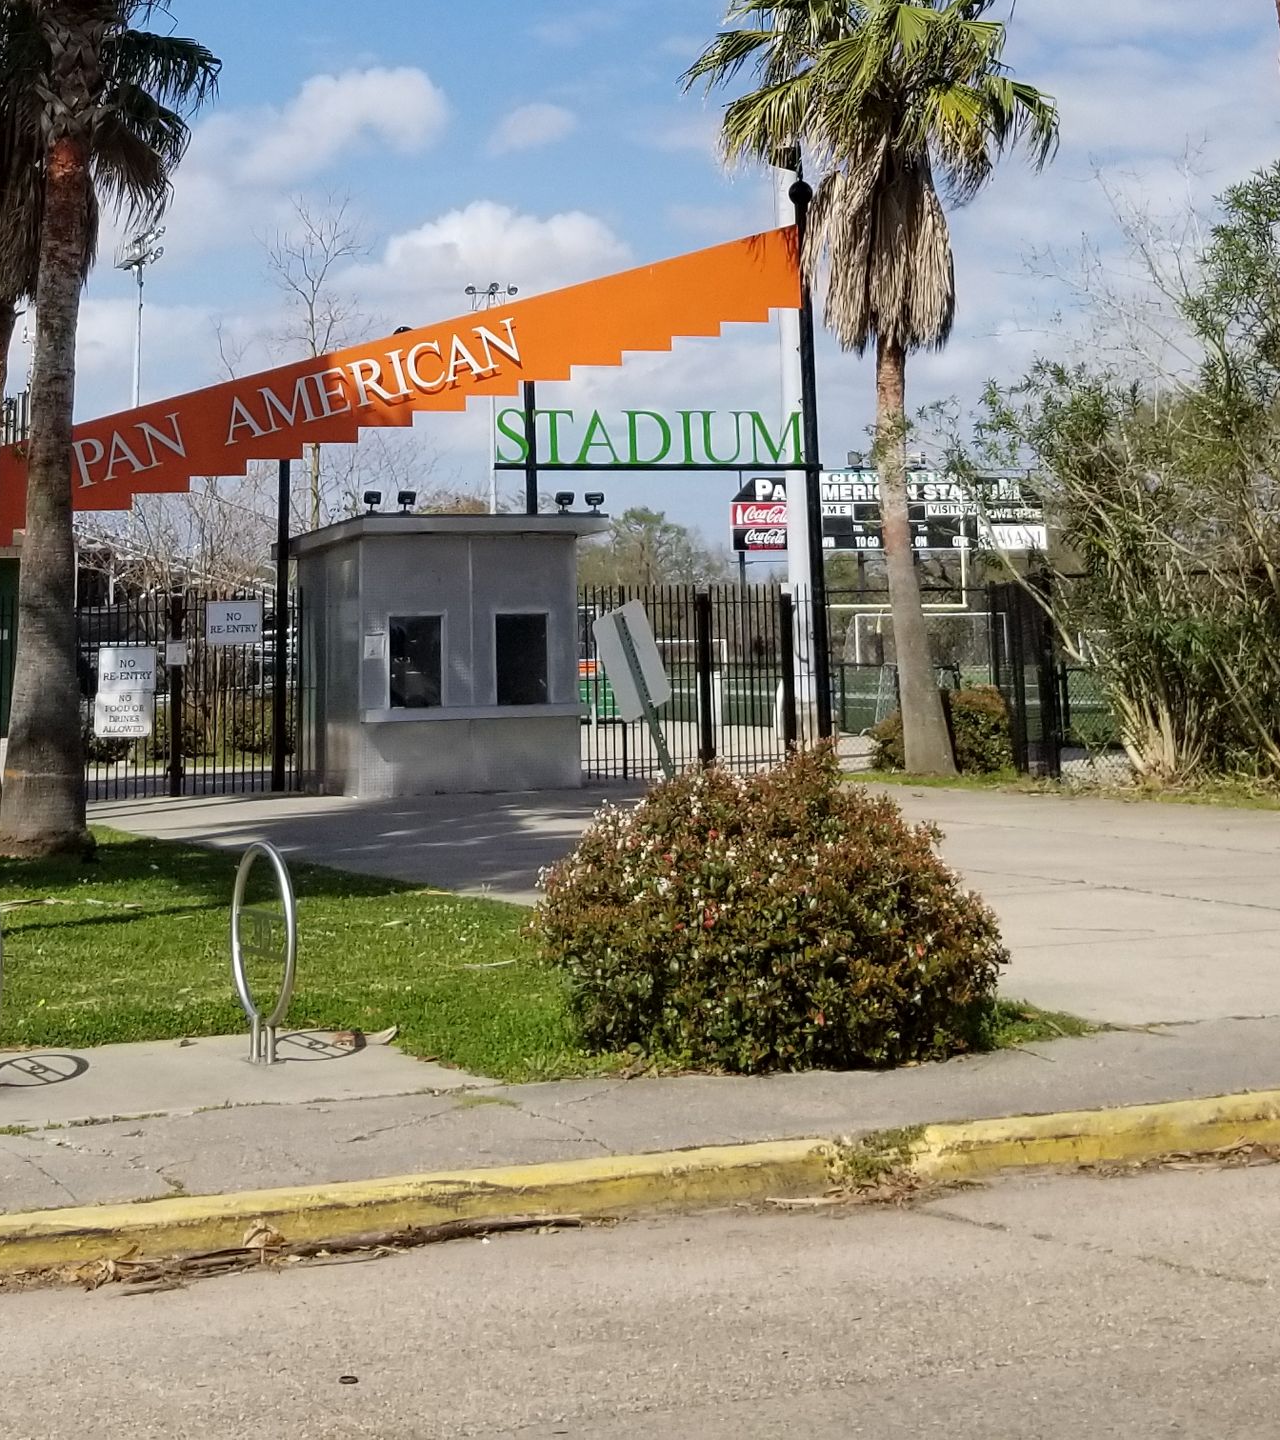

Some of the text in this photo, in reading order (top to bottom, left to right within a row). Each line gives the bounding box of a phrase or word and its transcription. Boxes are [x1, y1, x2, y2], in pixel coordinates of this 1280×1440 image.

[71, 317, 522, 488] PAN AMERICAN
[496, 408, 805, 464] STADIUM
[855, 536, 867, 548] TO
[867, 536, 880, 548] GO
[226, 612, 242, 621] NO
[210, 624, 258, 634] RE-ENTRY
[119, 659, 136, 668] NO
[103, 671, 152, 681] RE-ENTRY
[119, 694, 132, 702] NO
[104, 704, 144, 712] FOOD OR
[108, 715, 140, 723] DRINKS
